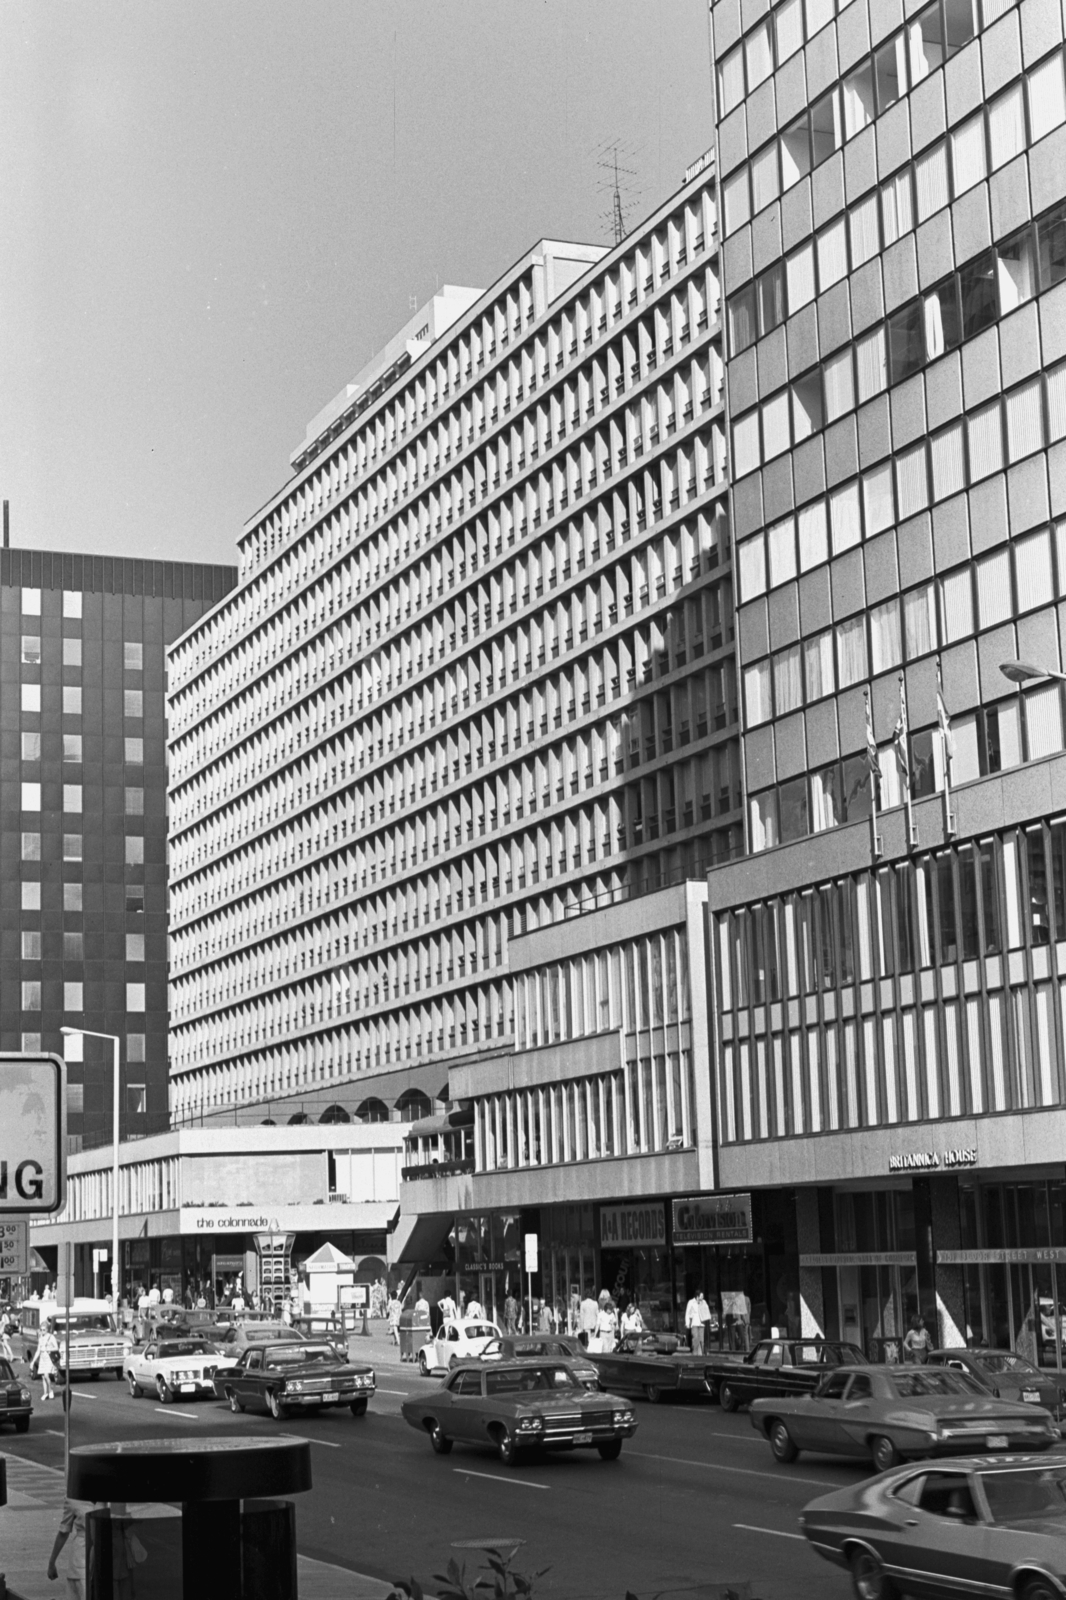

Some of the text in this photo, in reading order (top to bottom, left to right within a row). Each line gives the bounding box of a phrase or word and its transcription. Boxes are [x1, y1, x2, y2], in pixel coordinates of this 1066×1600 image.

[889, 1148, 977, 1171] BRITANNICA HOUSE
[196, 1215, 268, 1229] the colonnade
[620, 1209, 665, 1241] RECORDS
[676, 1229, 748, 1241] TELEVISION RENTALS
[1036, 1249, 1061, 1260] WEST
[488, 1261, 504, 1271] BOOKS
